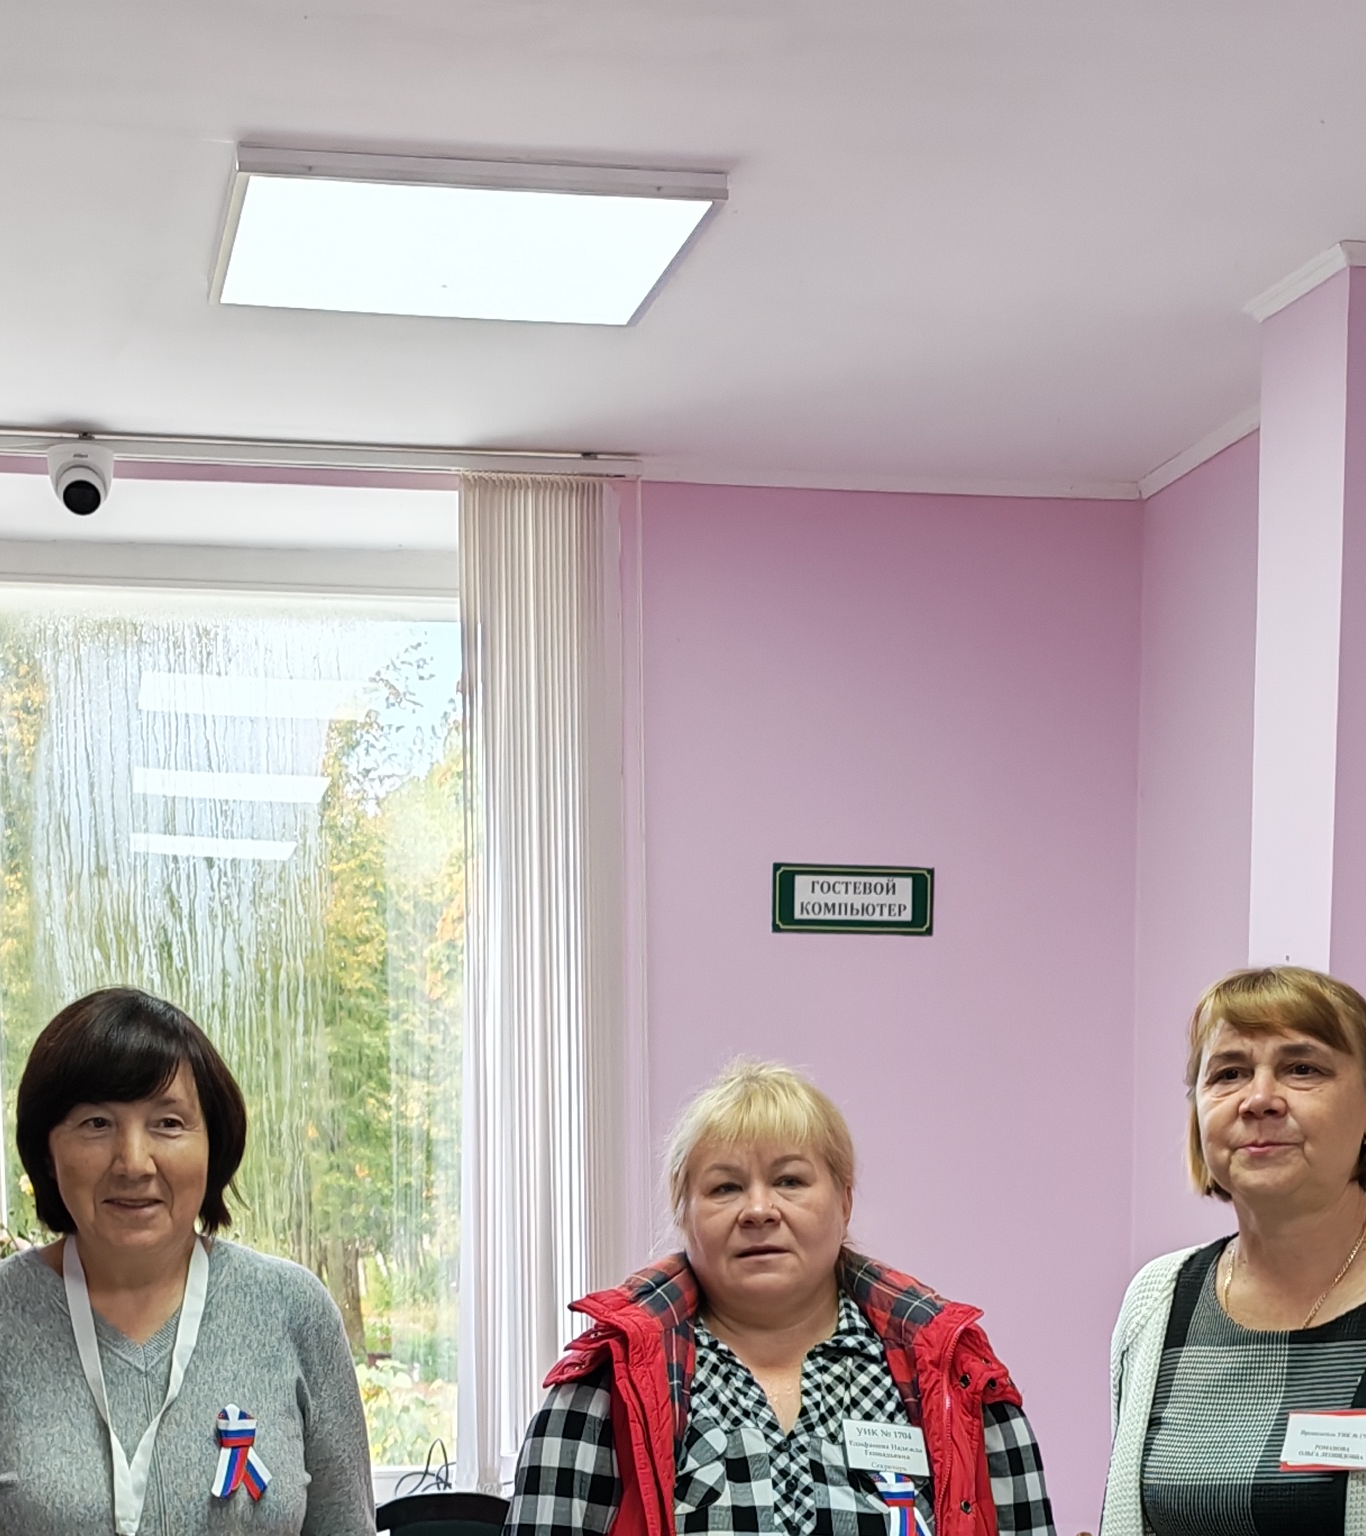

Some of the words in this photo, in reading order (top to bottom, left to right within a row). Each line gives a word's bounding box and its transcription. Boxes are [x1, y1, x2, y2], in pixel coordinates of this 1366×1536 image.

[810, 879, 896, 896] ГОСТЕВОЙ
[800, 901, 907, 917] КОМПЬЮТЕР
[856, 1427, 879, 1437] УИК
[881, 1430, 891, 1438] №
[894, 1431, 912, 1440] 1704
